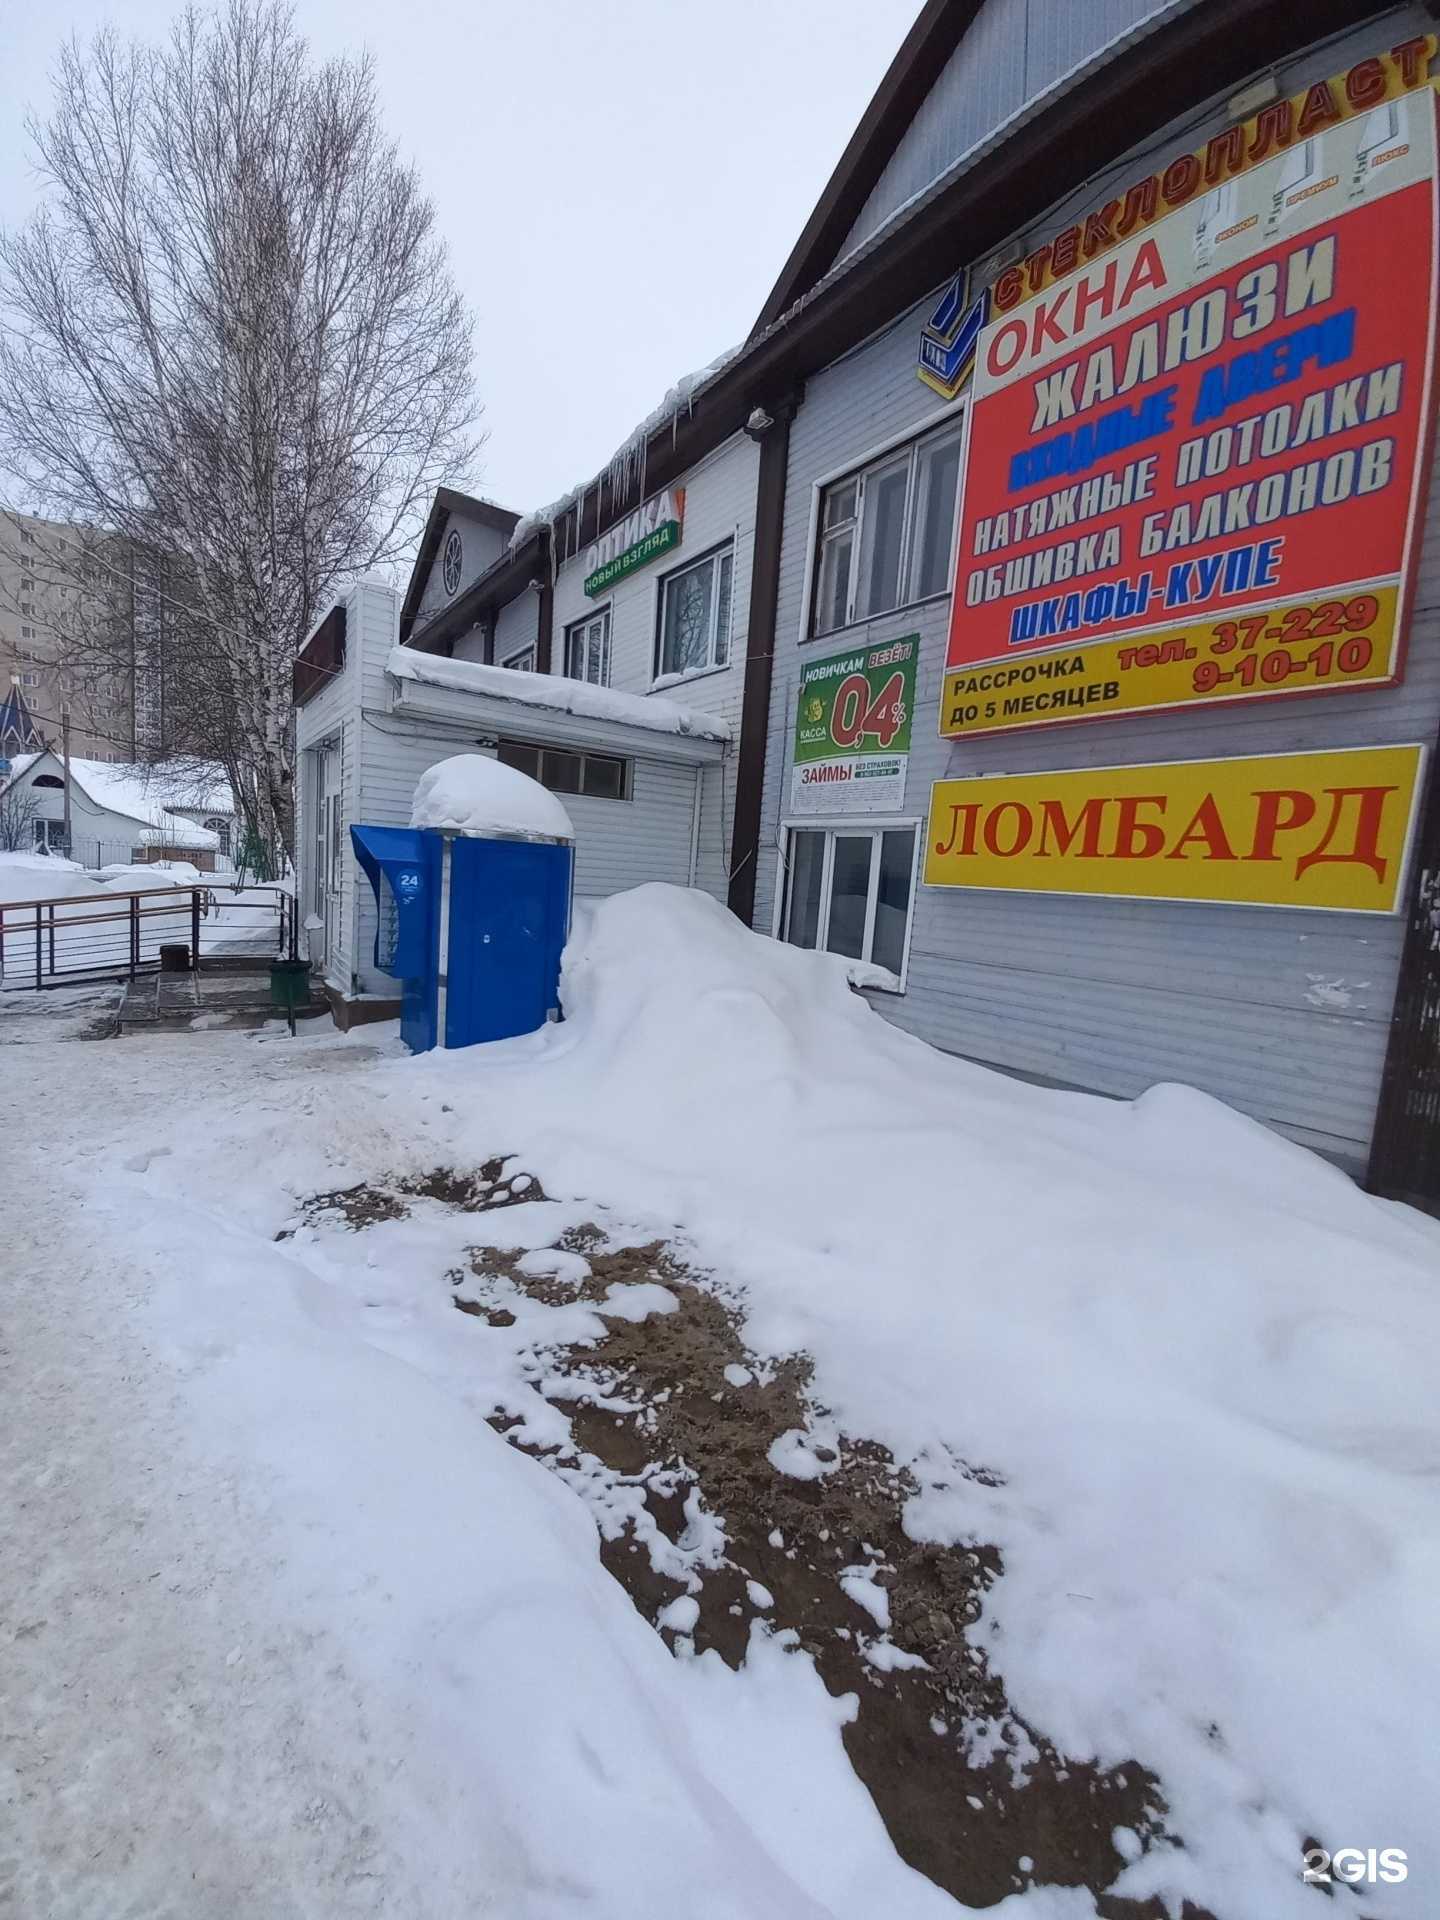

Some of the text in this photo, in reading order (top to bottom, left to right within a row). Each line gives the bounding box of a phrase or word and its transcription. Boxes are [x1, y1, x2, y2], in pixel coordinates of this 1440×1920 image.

[994, 36, 1429, 310] СТЕКЛОПЛАСТ
[986, 238, 1168, 377] ОКНА
[1030, 235, 1337, 433] ЖАЛЮЗИ
[1008, 307, 1357, 492] ВХОДНЫЕ ДВЕРИ
[973, 362, 1403, 556] НАТЯЖНЫЕ ПОТОЛКИ
[586, 527, 670, 593] НОВЫЙ ВЗГЛЯД
[587, 490, 673, 575] ОПТИКА
[966, 438, 1396, 607] ОБШИВКА БАЛКОНОВ
[1008, 537, 1286, 645] ШКАФЫ-КУПЕ
[805, 656, 865, 683] НОВИЧКАМ
[953, 595, 1379, 697] РАССРОЧКА тел. 37-229
[1192, 639, 1373, 693] 9-10-10
[950, 681, 1121, 726] ДО 5 МЕСЯЦЕВ
[801, 763, 853, 784] ЗАЙМЫ
[401, 874, 419, 886] 24
[936, 786, 1399, 884] ЛОМБАРД
